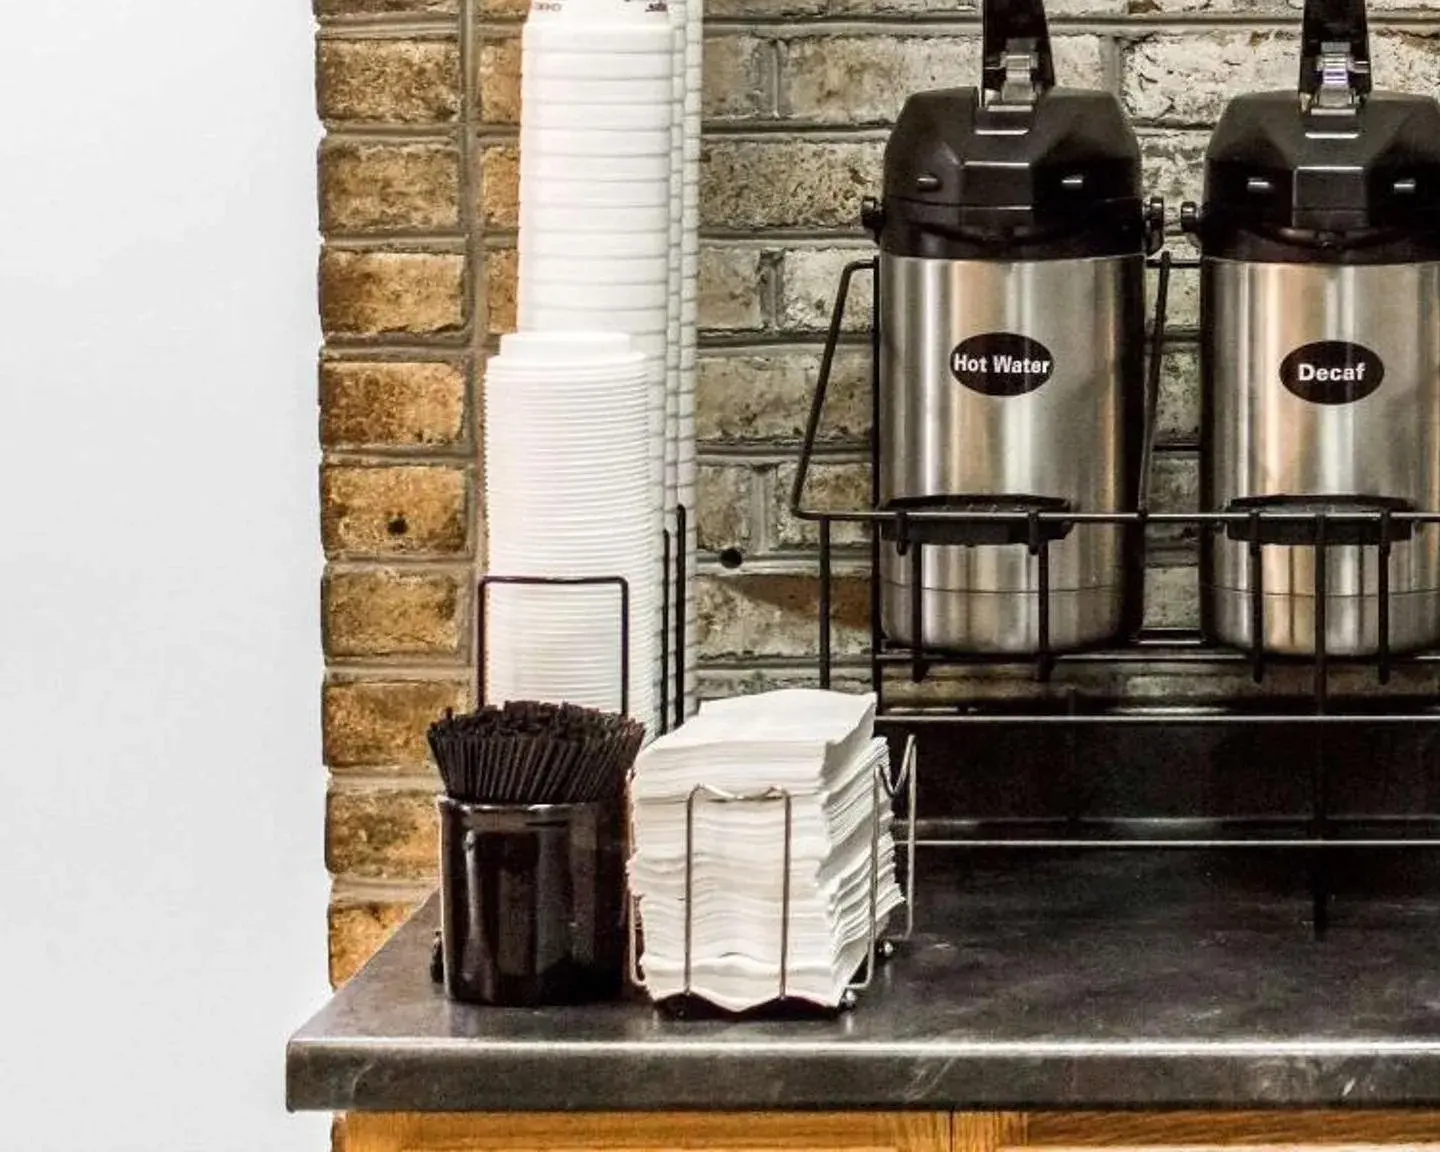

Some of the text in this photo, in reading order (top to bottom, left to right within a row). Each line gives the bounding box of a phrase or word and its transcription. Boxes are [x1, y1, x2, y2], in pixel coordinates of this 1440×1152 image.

[953, 352, 1051, 374] Hot Water
[1297, 361, 1366, 382] Decaf
